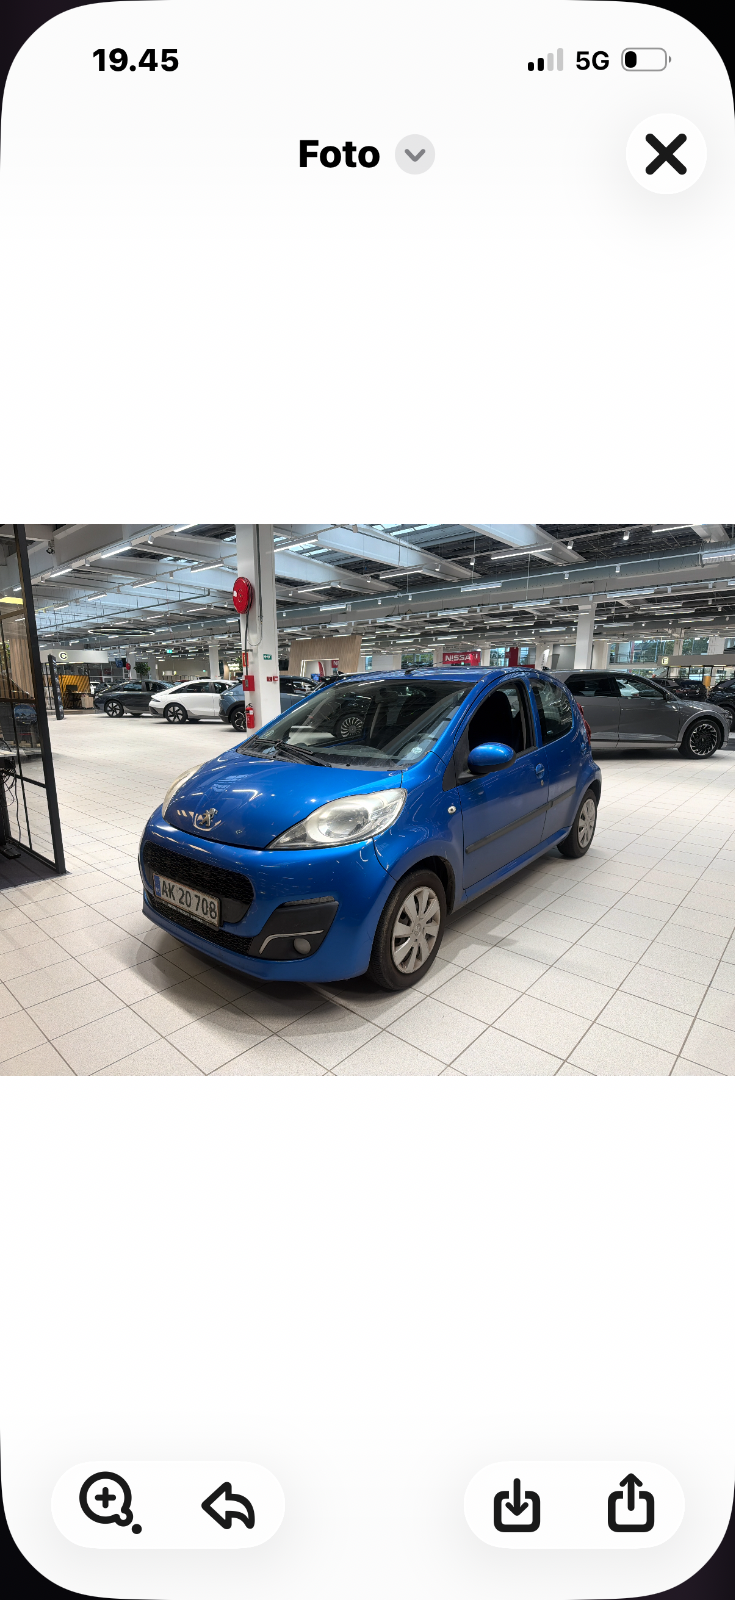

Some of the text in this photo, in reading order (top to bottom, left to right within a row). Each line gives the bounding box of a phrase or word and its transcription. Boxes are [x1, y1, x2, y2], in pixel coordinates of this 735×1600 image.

[161, 880, 175, 901] AK
[178, 887, 192, 908] 20
[194, 894, 217, 919] 708
